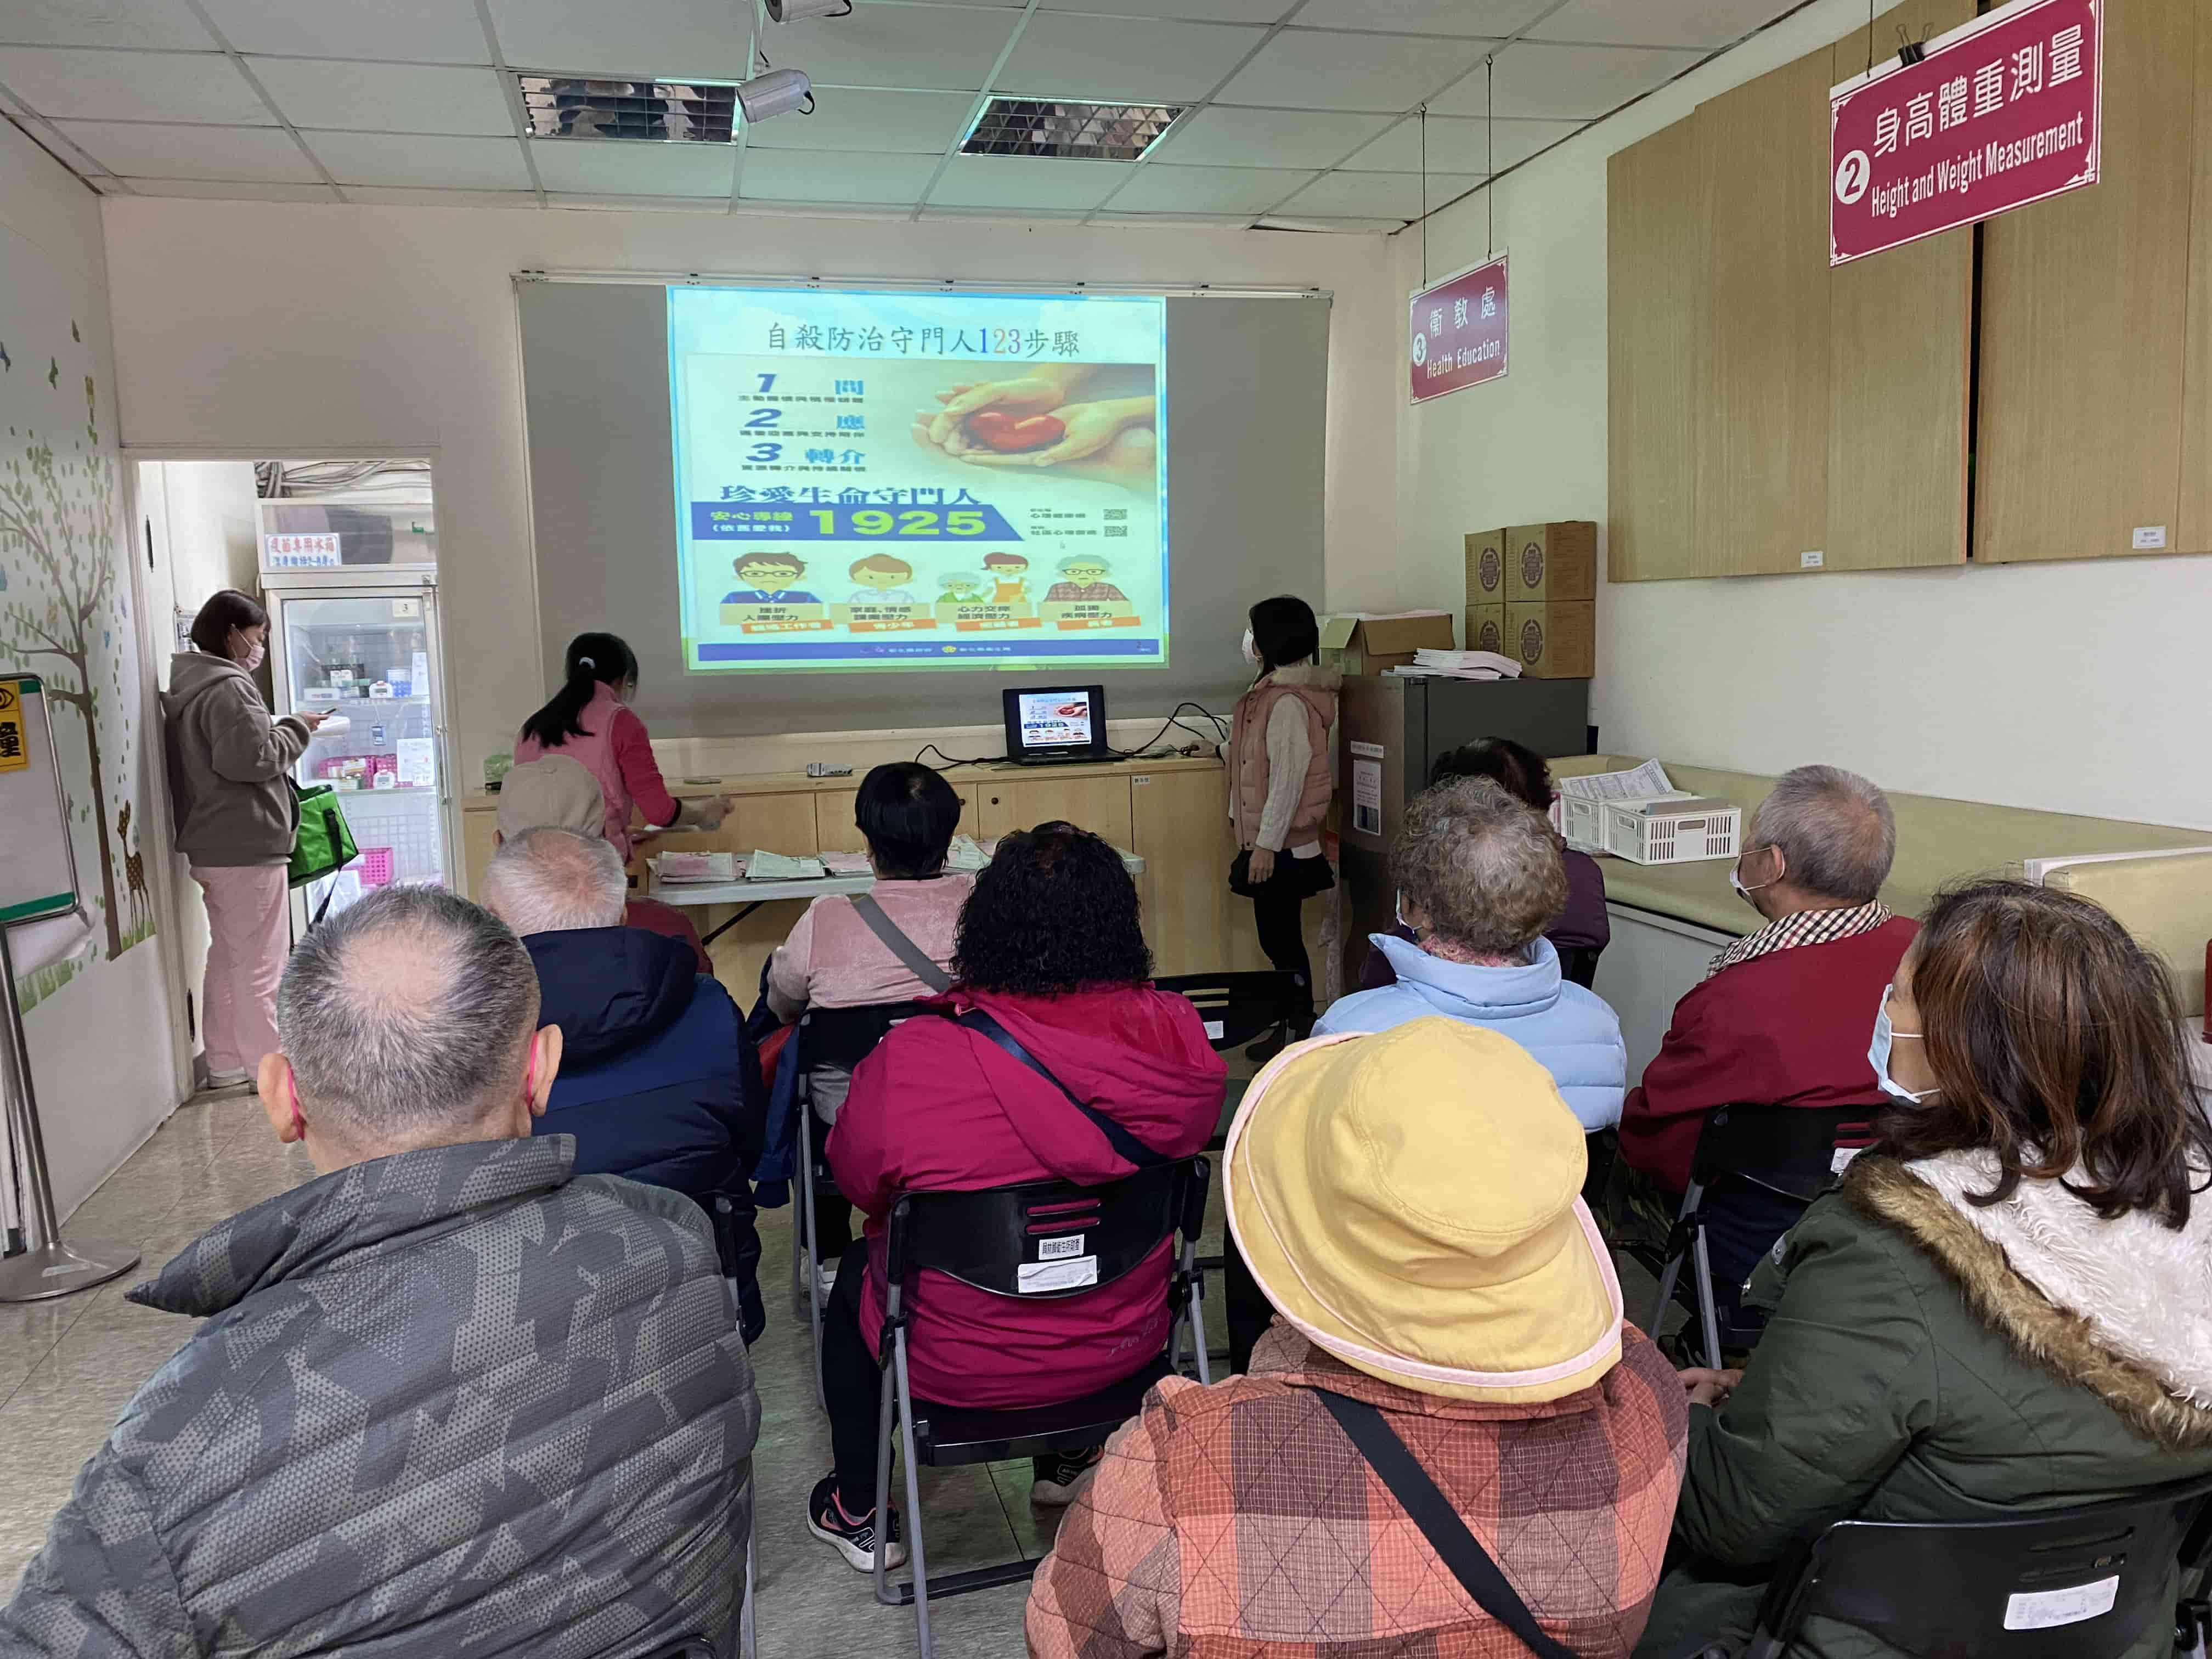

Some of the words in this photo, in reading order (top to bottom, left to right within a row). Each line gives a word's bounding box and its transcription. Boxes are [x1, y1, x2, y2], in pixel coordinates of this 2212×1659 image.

[1873, 24, 2085, 158] 身高體重測量
[1843, 157, 1861, 197] 2
[1871, 176, 1910, 218] Height
[1911, 166, 1934, 203] and
[1937, 149, 1983, 194] Weight
[1985, 110, 2084, 177] Measurement
[1430, 285, 1497, 338] 衛教處
[768, 321, 1080, 359] 自殺防治守門人123步驟
[1426, 353, 1453, 379] Health
[1457, 338, 1500, 369] Education
[757, 373, 777, 393] 1
[744, 408, 782, 427] 2
[745, 442, 783, 462] 3
[805, 448, 867, 465] 轉介
[719, 485, 981, 505] 珍愛生命守門人
[809, 510, 986, 535] 1925
